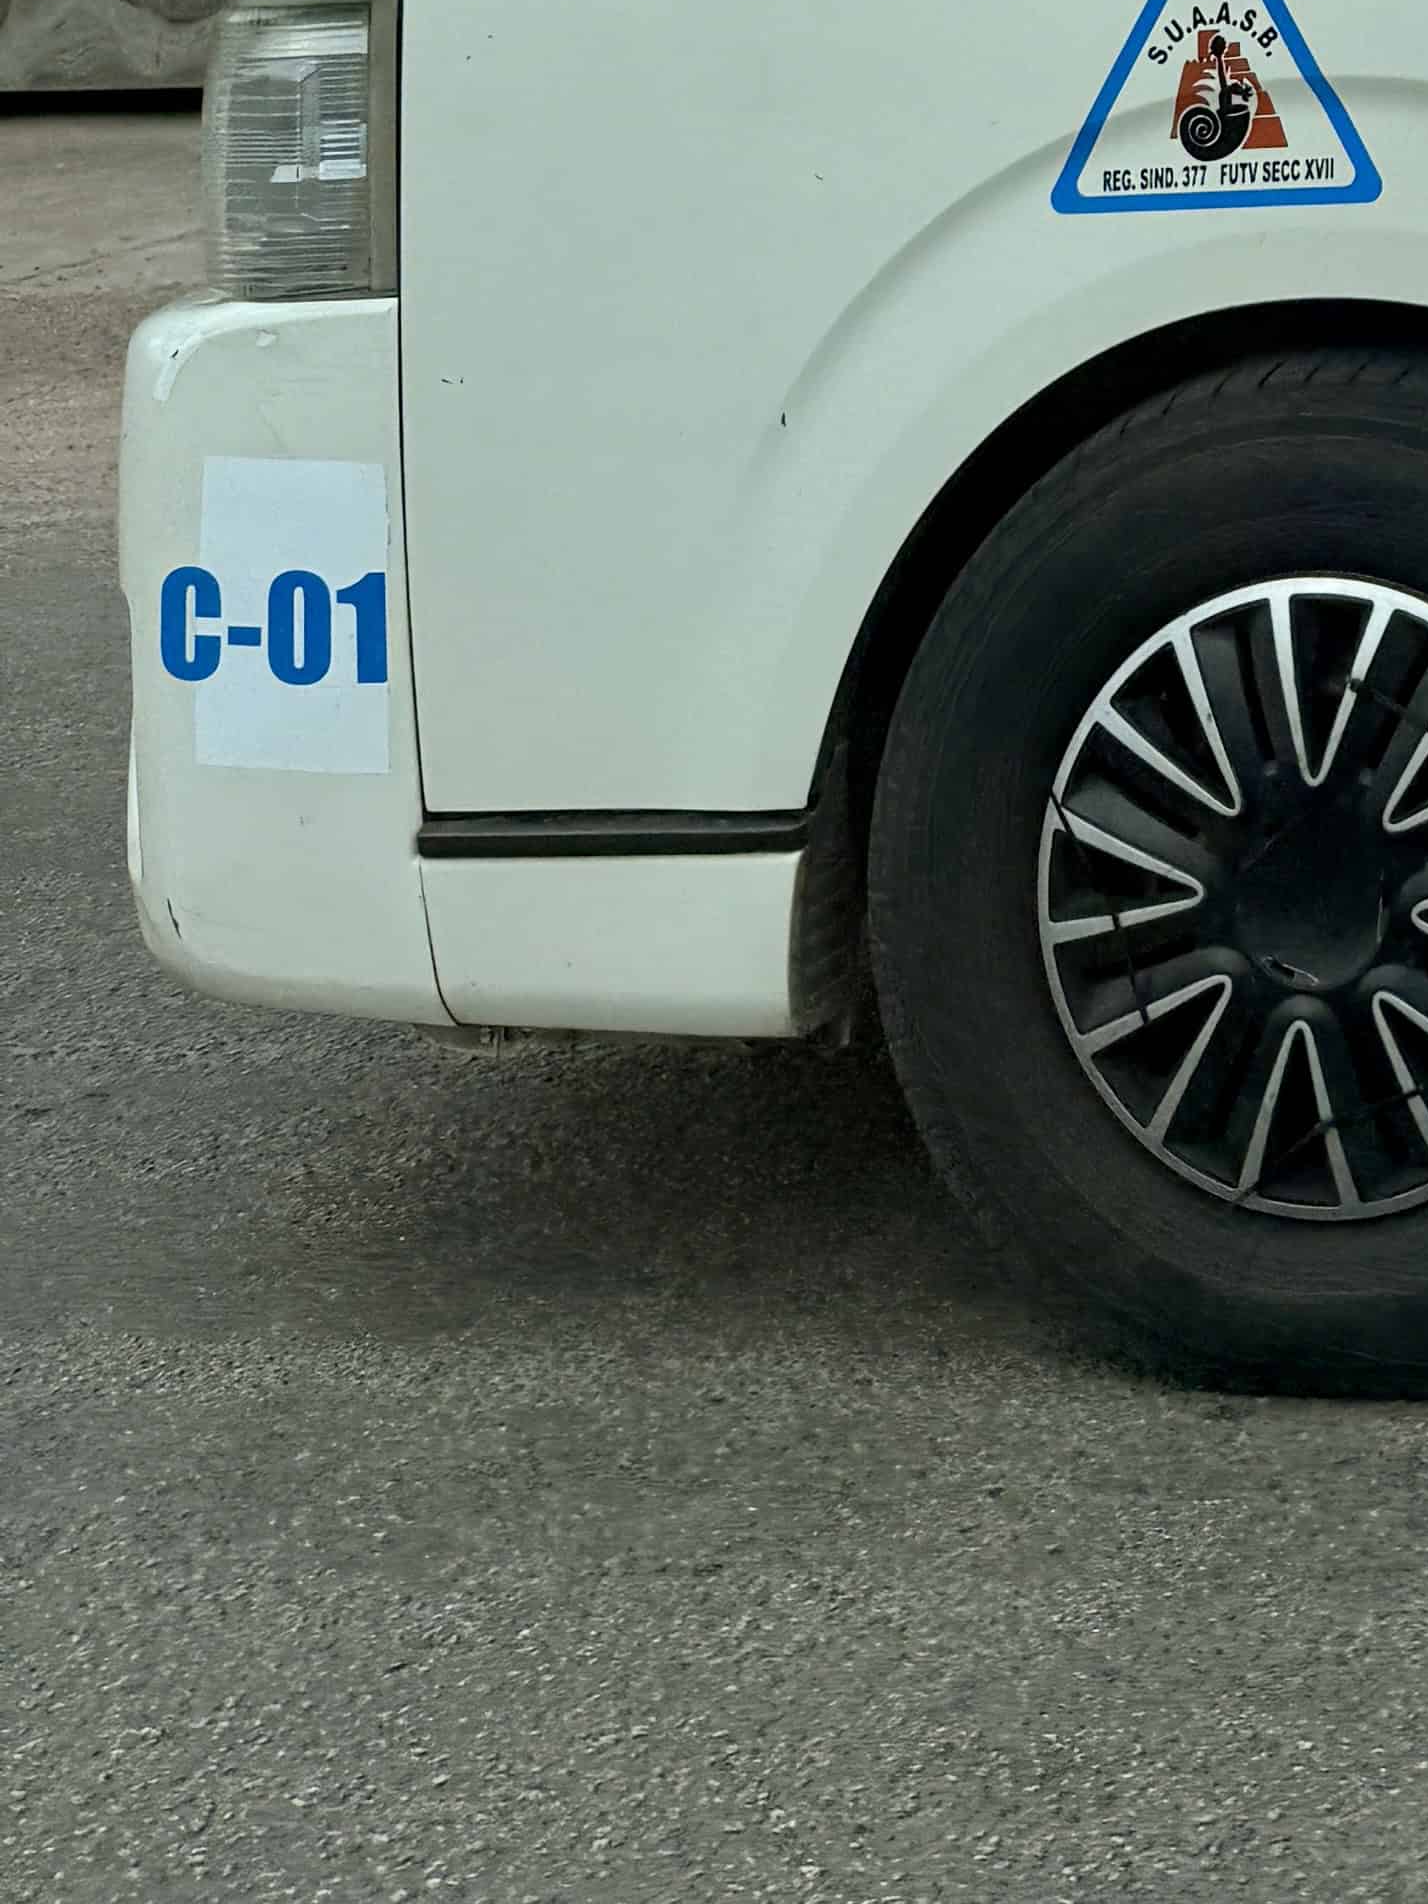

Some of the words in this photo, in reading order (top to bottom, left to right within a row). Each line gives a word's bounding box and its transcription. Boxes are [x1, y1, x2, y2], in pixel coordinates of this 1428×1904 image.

[1103, 169, 1136, 192] REG.
[1140, 167, 1178, 190] SIND.
[1182, 165, 1208, 188] 377
[1220, 162, 1259, 186] FUTV
[1262, 159, 1300, 182] SECC
[1305, 157, 1335, 180] XVII
[160, 565, 389, 686] C-01
